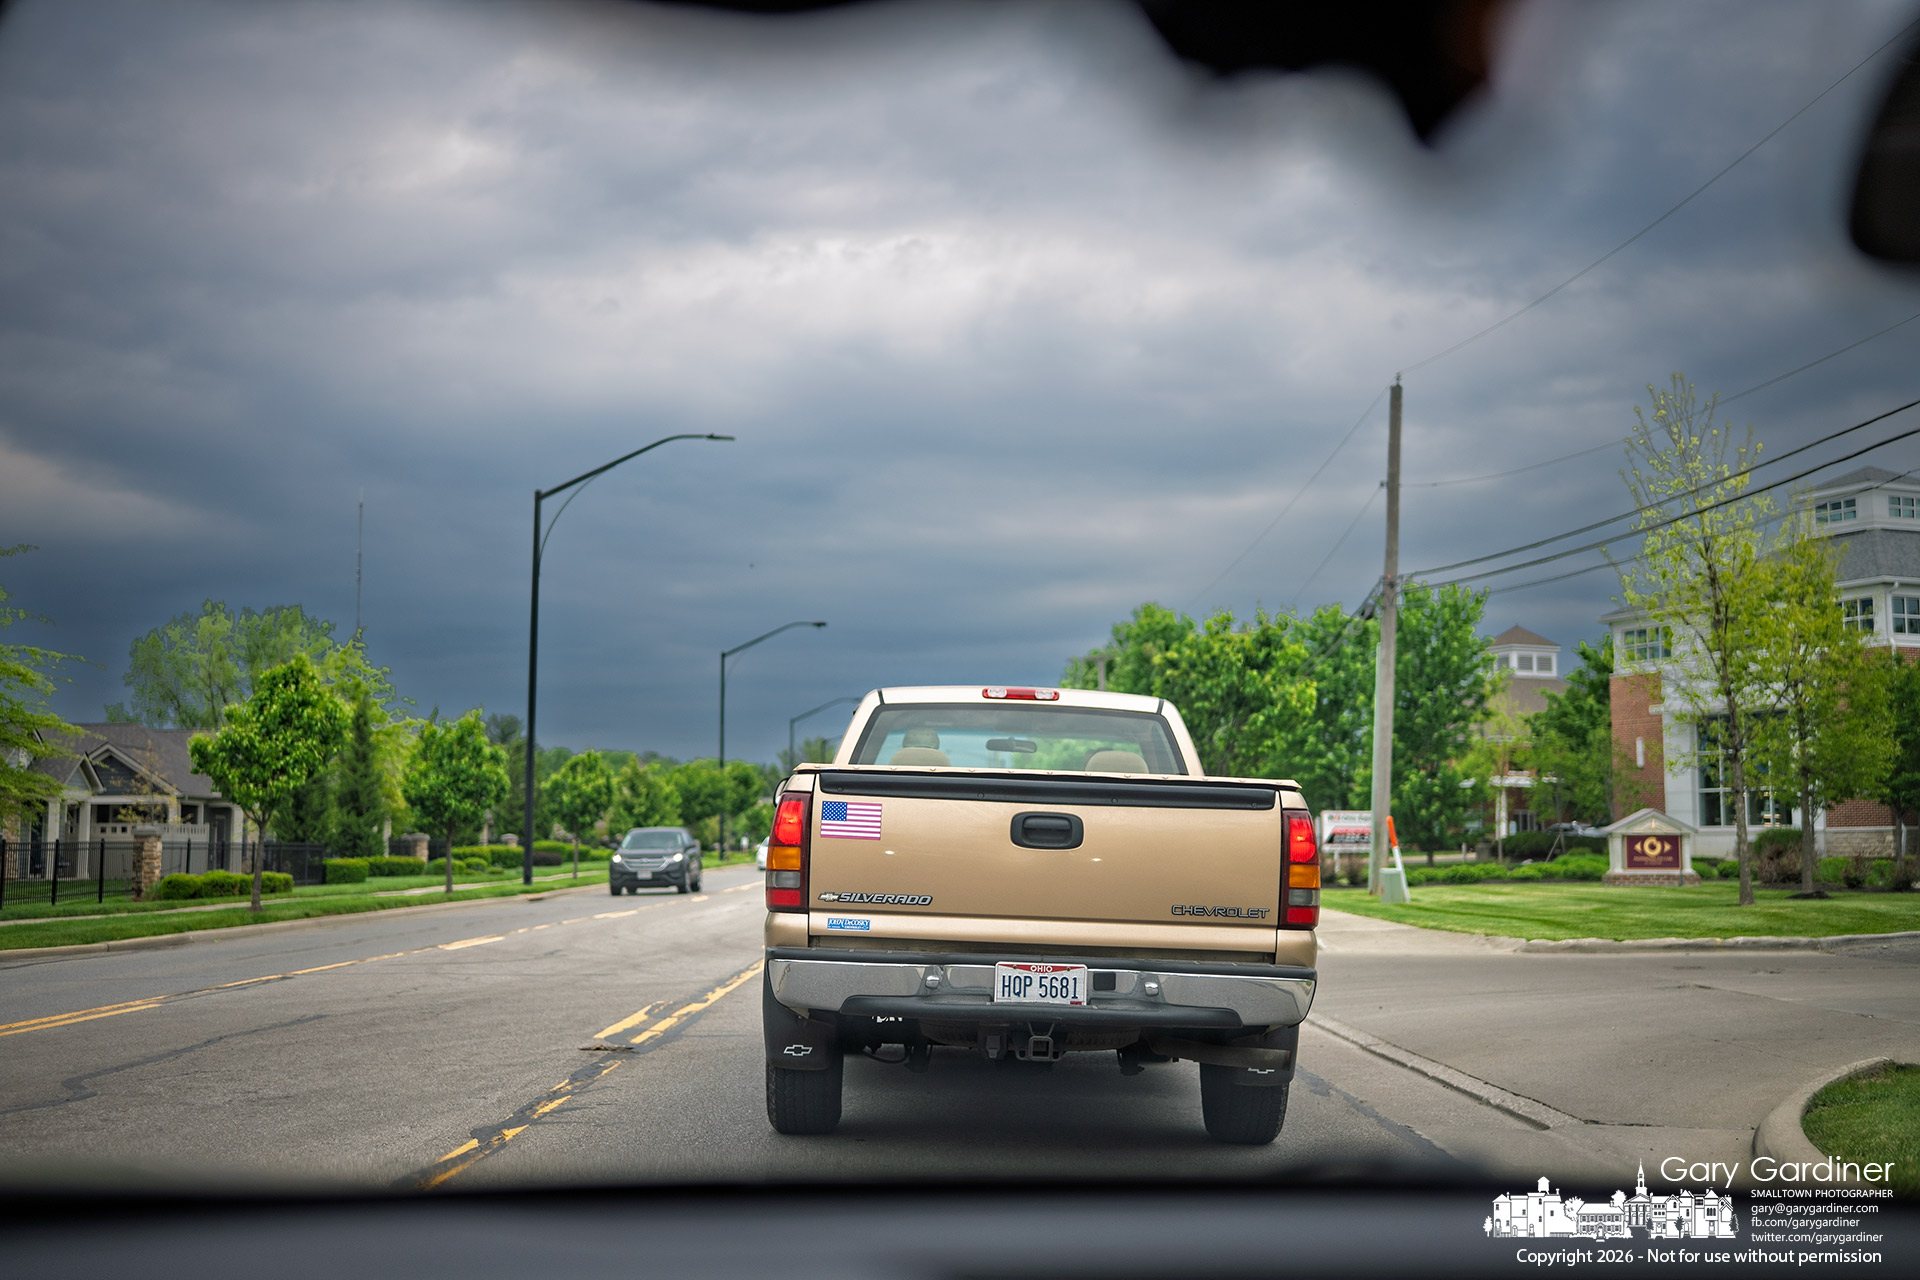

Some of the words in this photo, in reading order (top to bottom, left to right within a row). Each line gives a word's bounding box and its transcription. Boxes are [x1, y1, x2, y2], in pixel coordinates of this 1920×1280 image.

[838, 892, 933, 906] SILVERADO
[1171, 904, 1270, 919] CHEVROLET
[1030, 965, 1053, 973] OHIO
[1002, 975, 1032, 998] HQP
[1039, 976, 1078, 999] 5681
